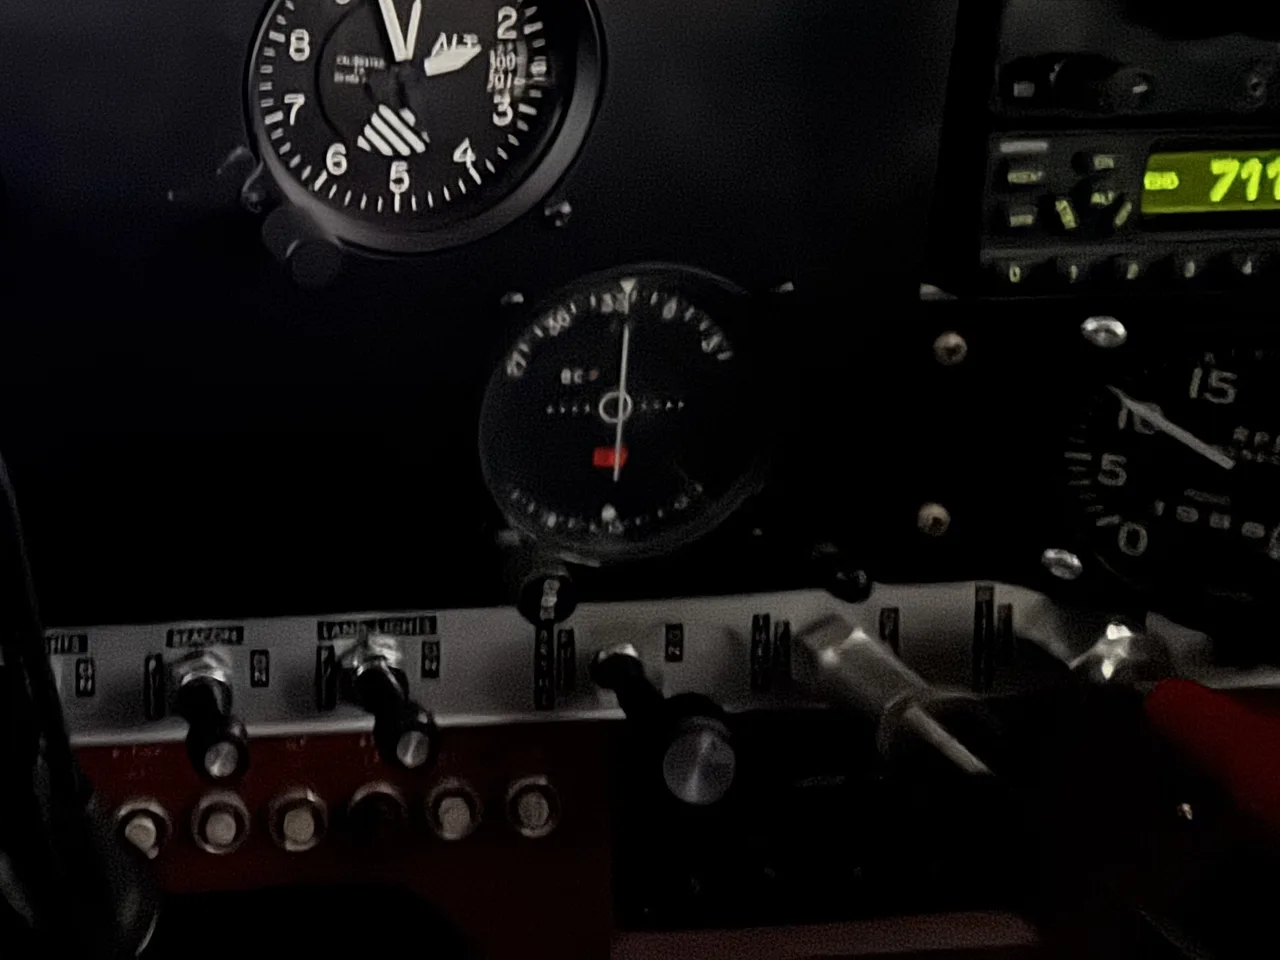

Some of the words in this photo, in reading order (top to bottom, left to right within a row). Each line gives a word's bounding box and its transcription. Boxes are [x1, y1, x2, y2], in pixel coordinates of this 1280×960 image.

[496, 6, 518, 40] 2
[288, 28, 311, 62] 8
[283, 92, 306, 126] 7
[492, 94, 514, 127] 3
[325, 142, 348, 176] 6
[452, 136, 476, 167] 4
[389, 159, 411, 194] 5
[1189, 364, 1239, 405] 15
[1096, 451, 1129, 487] 5
[1117, 520, 1149, 557] 0
